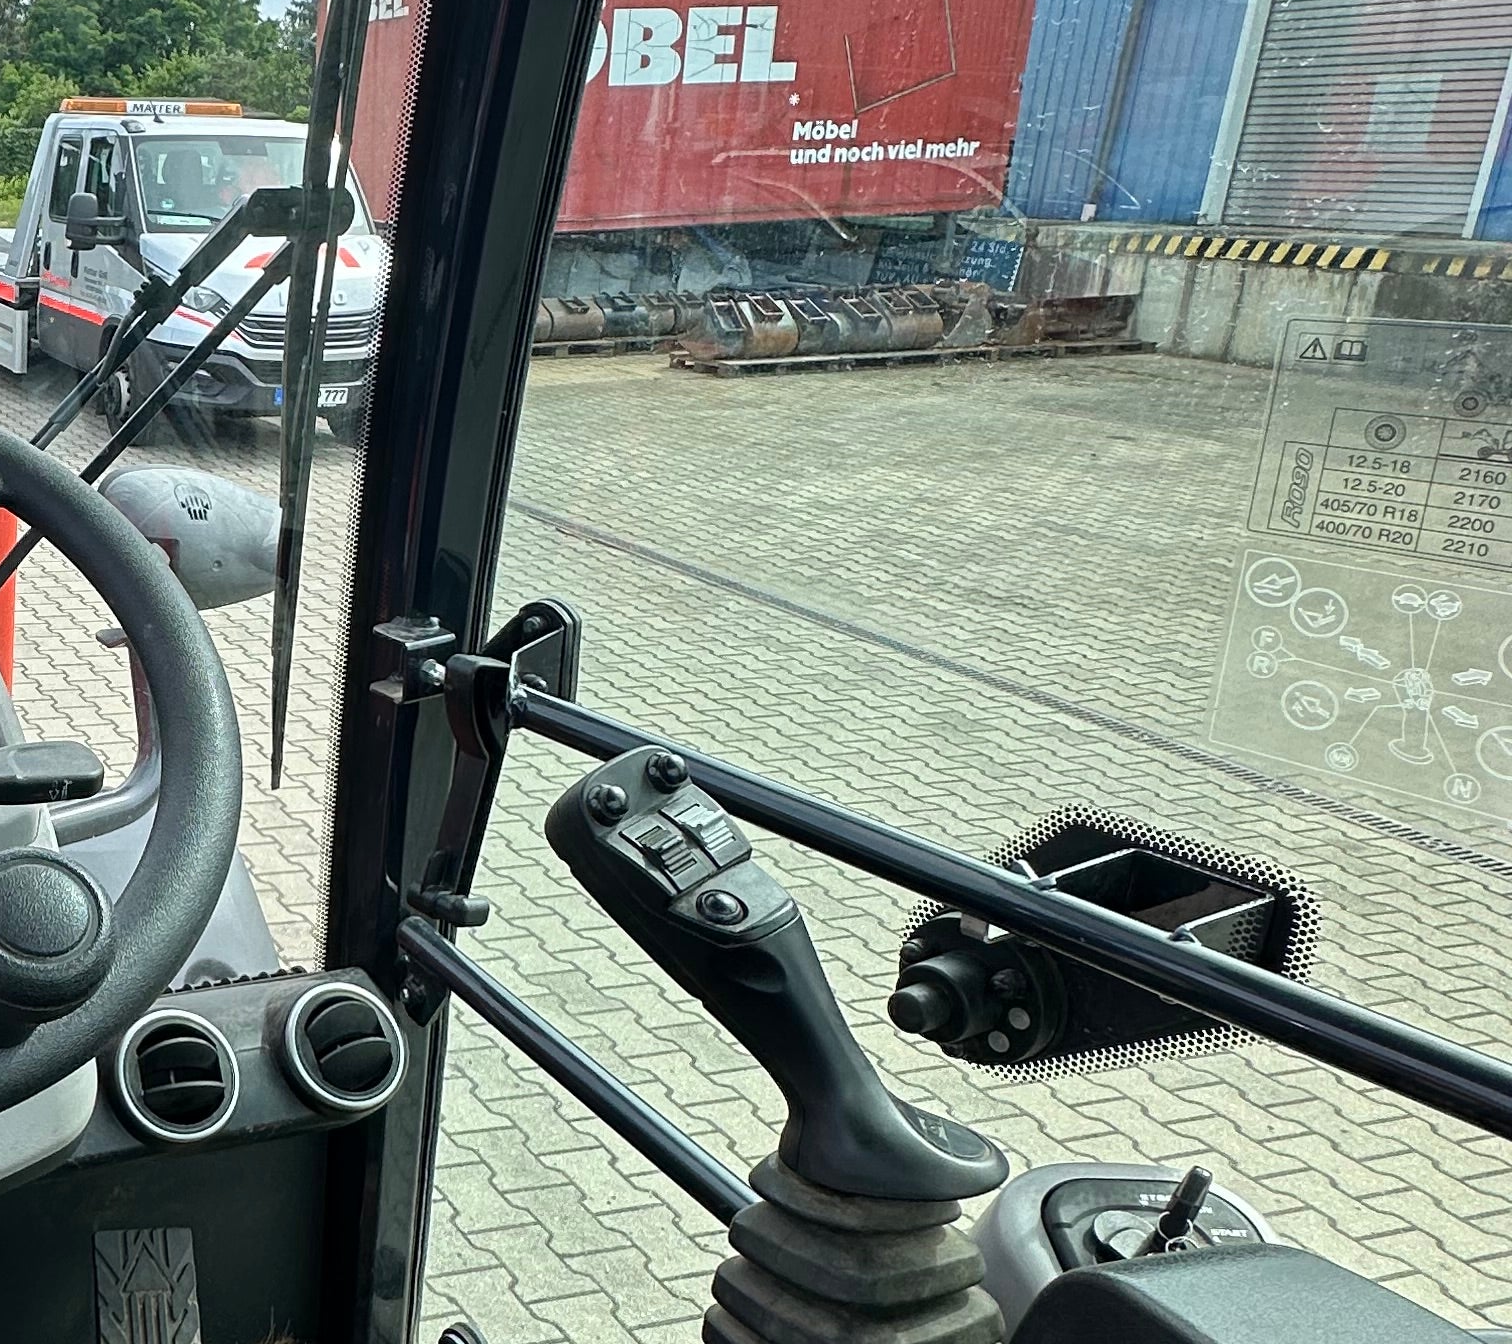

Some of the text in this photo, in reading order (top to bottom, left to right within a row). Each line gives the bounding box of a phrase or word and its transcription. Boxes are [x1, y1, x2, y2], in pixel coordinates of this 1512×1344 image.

[130, 103, 183, 114] MATTER
[792, 119, 859, 141] Möbel
[790, 137, 980, 165] und noch viel mehr
[325, 389, 347, 403] 777
[1347, 454, 1507, 486] 12.5-18 2160
[1343, 477, 1501, 510] 12.5-20 2170
[1319, 498, 1495, 534] 405/70 R18 2200
[1315, 519, 1489, 557] 400/70 R20 2210
[1259, 630, 1275, 647] F
[1253, 656, 1269, 673] R
[1451, 779, 1473, 798] N
